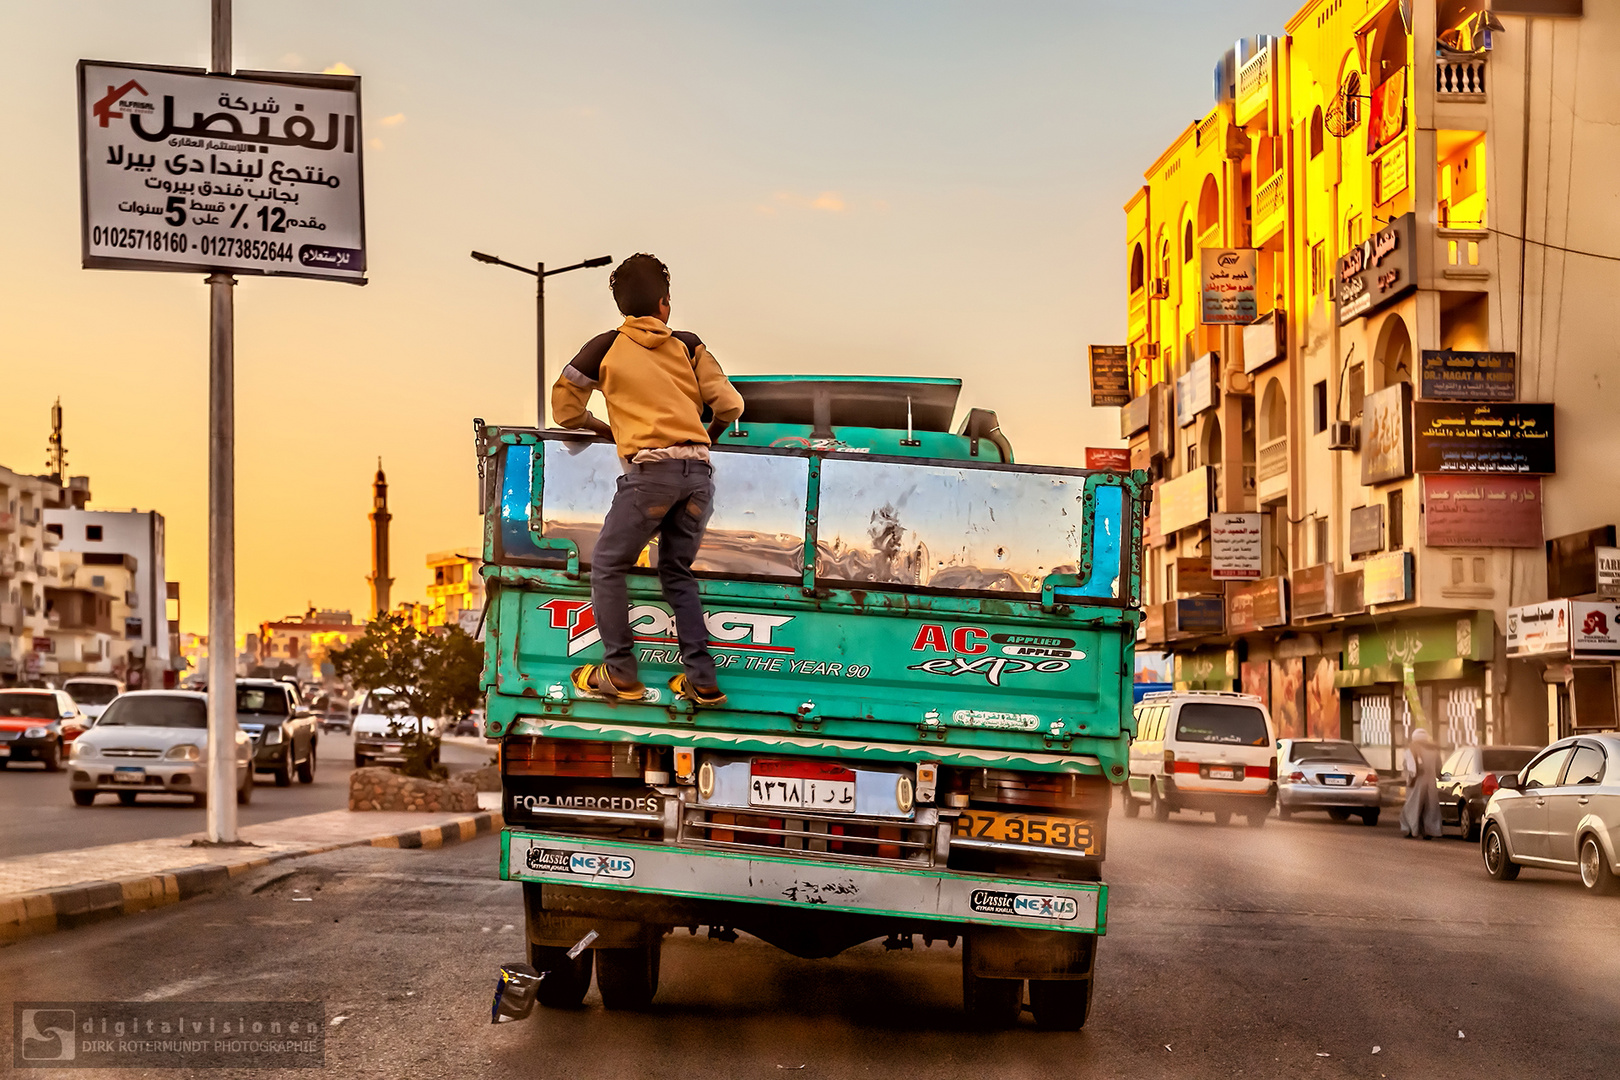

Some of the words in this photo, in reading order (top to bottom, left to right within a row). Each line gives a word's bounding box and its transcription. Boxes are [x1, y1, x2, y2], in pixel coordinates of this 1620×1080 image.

[217, 92, 280, 114] شركة
[130, 95, 355, 154] الفيصل
[106, 145, 155, 173] بيرلا
[268, 160, 340, 188] منتجع
[144, 176, 196, 195] بيروت
[198, 181, 244, 198] فندق
[247, 186, 300, 206] بجانب
[118, 200, 164, 217] سنوات
[164, 195, 187, 227] 5
[189, 199, 226, 213] قسط
[191, 214, 220, 226] على
[285, 216, 327, 231] مقدم
[92, 225, 188, 254] 01025718160
[201, 234, 294, 263] 01273852644
[1446, 356, 1475, 367] محمد
[1442, 371, 1475, 381] NAGAT
[1470, 415, 1504, 427] محمد
[1455, 428, 1480, 438] العامة
[1520, 606, 1555, 627] صيدلية
[911, 624, 990, 656] AC
[1006, 635, 1062, 647] APPLIED
[1017, 647, 1073, 658] APPLIED
[714, 654, 738, 668] OF
[743, 655, 785, 672] THE
[786, 660, 843, 677] YEAR
[845, 663, 871, 679] 90
[906, 655, 1072, 687] expo
[753, 780, 800, 803] ٩٣٦٨
[513, 795, 551, 811] FOR
[556, 795, 659, 813] MERCEDES
[953, 814, 997, 840] RZ
[1004, 818, 1094, 849] 3538
[571, 855, 632, 875] NEXUS
[973, 891, 1014, 908] Classic
[1015, 898, 1075, 915] NEXUS
